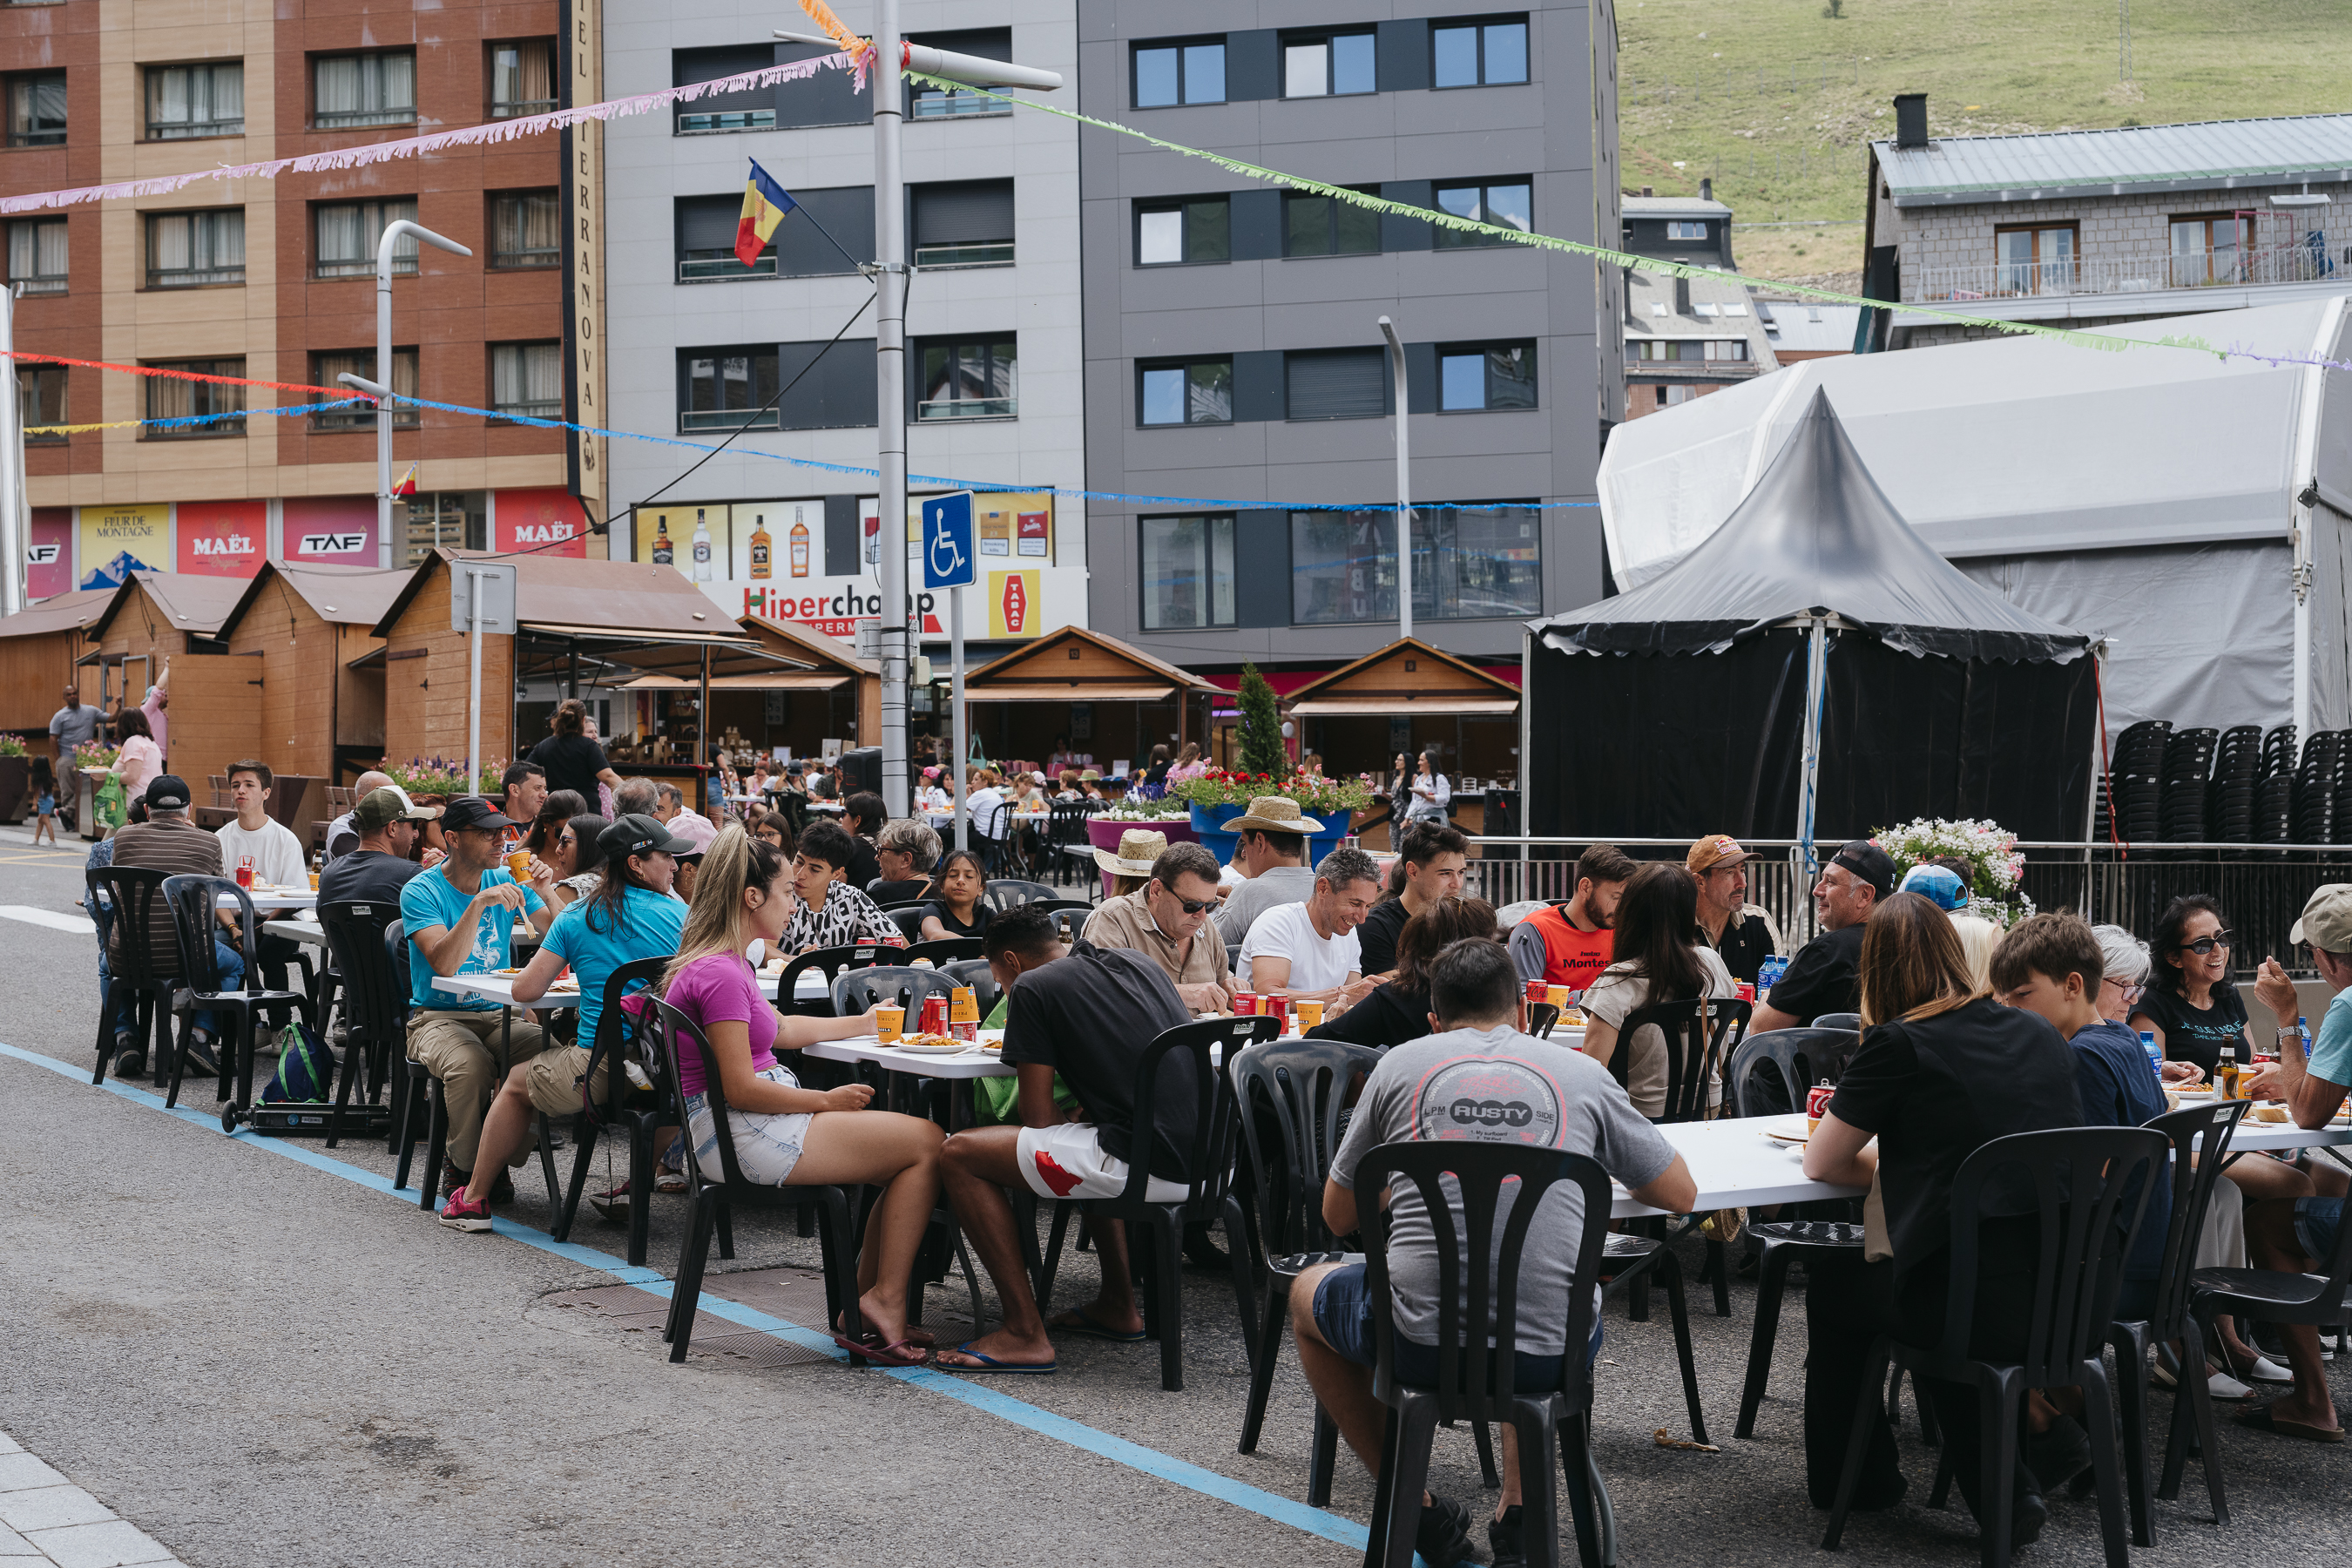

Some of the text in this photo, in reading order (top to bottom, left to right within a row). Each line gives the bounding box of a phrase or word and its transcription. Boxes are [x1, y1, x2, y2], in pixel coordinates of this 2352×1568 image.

[132, 515, 146, 526] DE
[97, 525, 153, 537] MONTAGNE
[515, 520, 579, 543] MAËL
[193, 533, 255, 555] MAËL
[306, 533, 362, 551] TAF
[743, 585, 935, 633] Hiperchap
[1010, 584, 1019, 626] TABAC
[1428, 1085, 1440, 1102] OWN
[1436, 1077, 1448, 1089] IND
[1447, 1064, 1479, 1080] RECORDS
[1530, 1078, 1552, 1112] AUSTRALIA
[1455, 1105, 1528, 1119] RUSTY
[1536, 1110, 1555, 1121] SIDE
